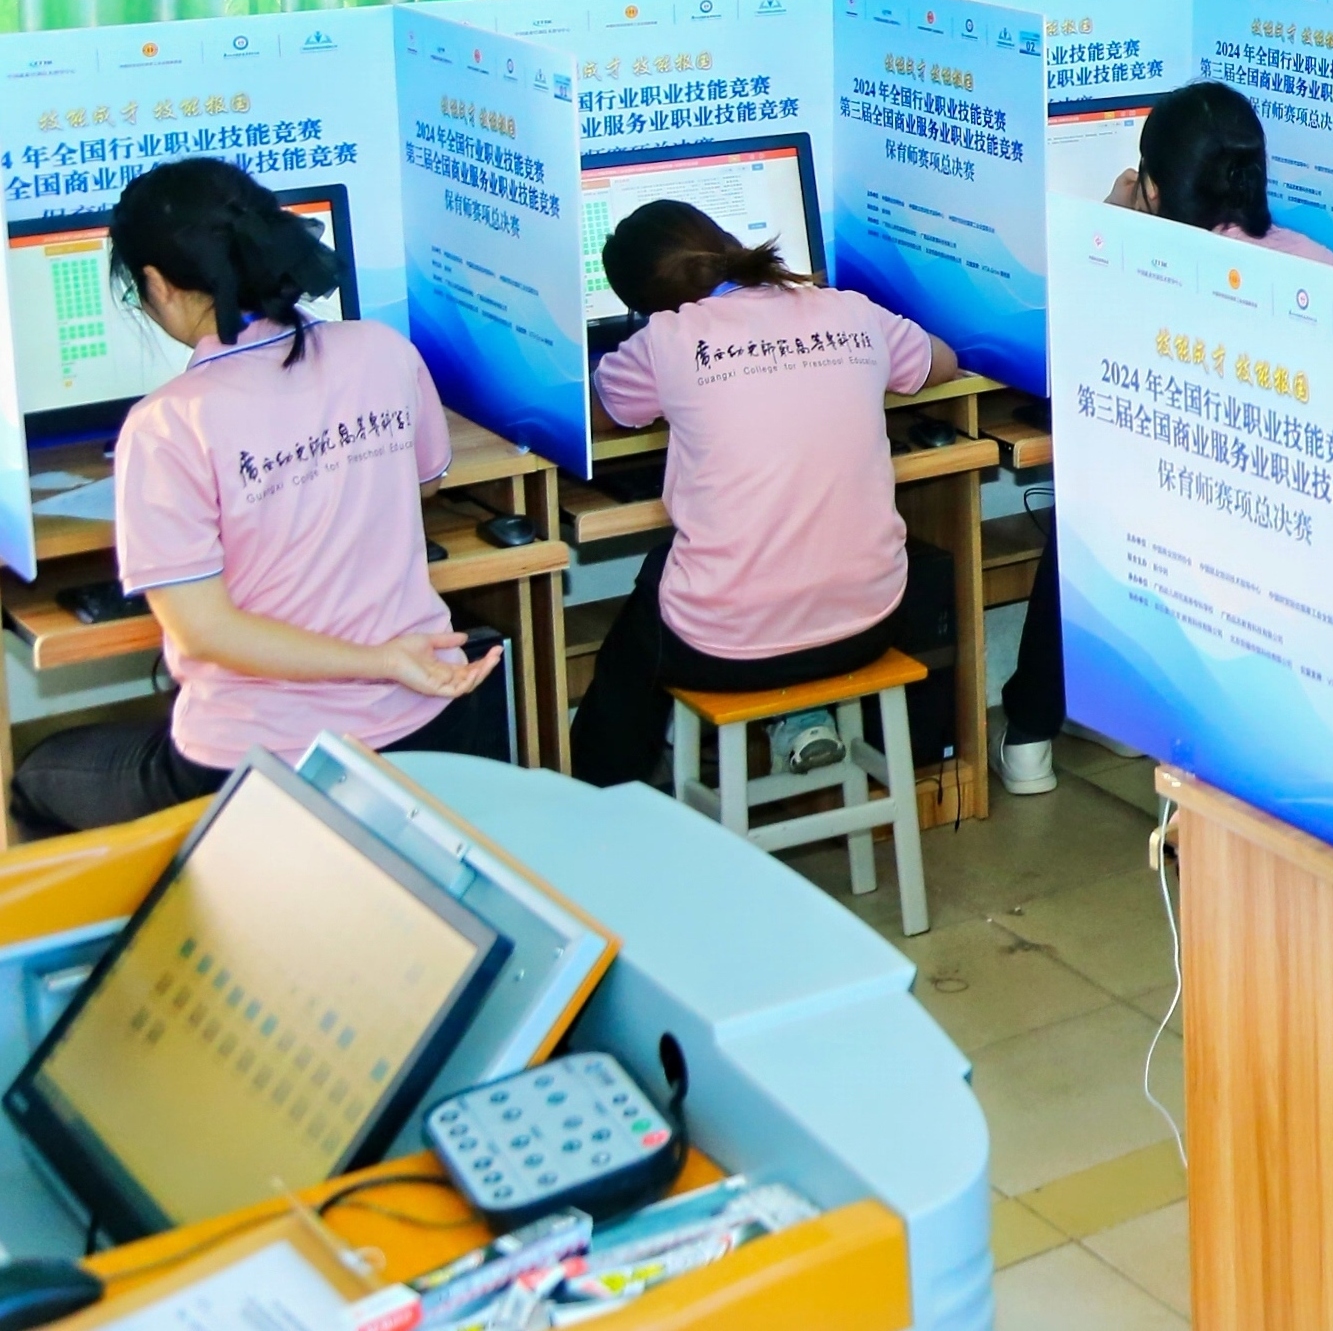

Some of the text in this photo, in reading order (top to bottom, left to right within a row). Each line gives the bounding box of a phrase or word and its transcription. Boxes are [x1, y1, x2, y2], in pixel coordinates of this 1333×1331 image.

[1024, 40, 1037, 53] 02
[1215, 40, 1241, 60] 2024
[853, 77, 1007, 133] 2024 年全国行业职业技能竞赛
[22, 117, 323, 168] 年全国行业职业技能竞赛
[415, 120, 436, 143] 2024
[840, 95, 1024, 164] 第三届全国商业服务业职业技能竞赛
[885, 137, 975, 183] 保育师赛项总决赛
[698, 369, 736, 386] Guangxi
[743, 362, 778, 375] College
[784, 362, 796, 370] for
[802, 358, 843, 368] Preschool
[1100, 358, 1141, 395] 2024
[1157, 458, 1313, 547] 保育师赛项总决赛
